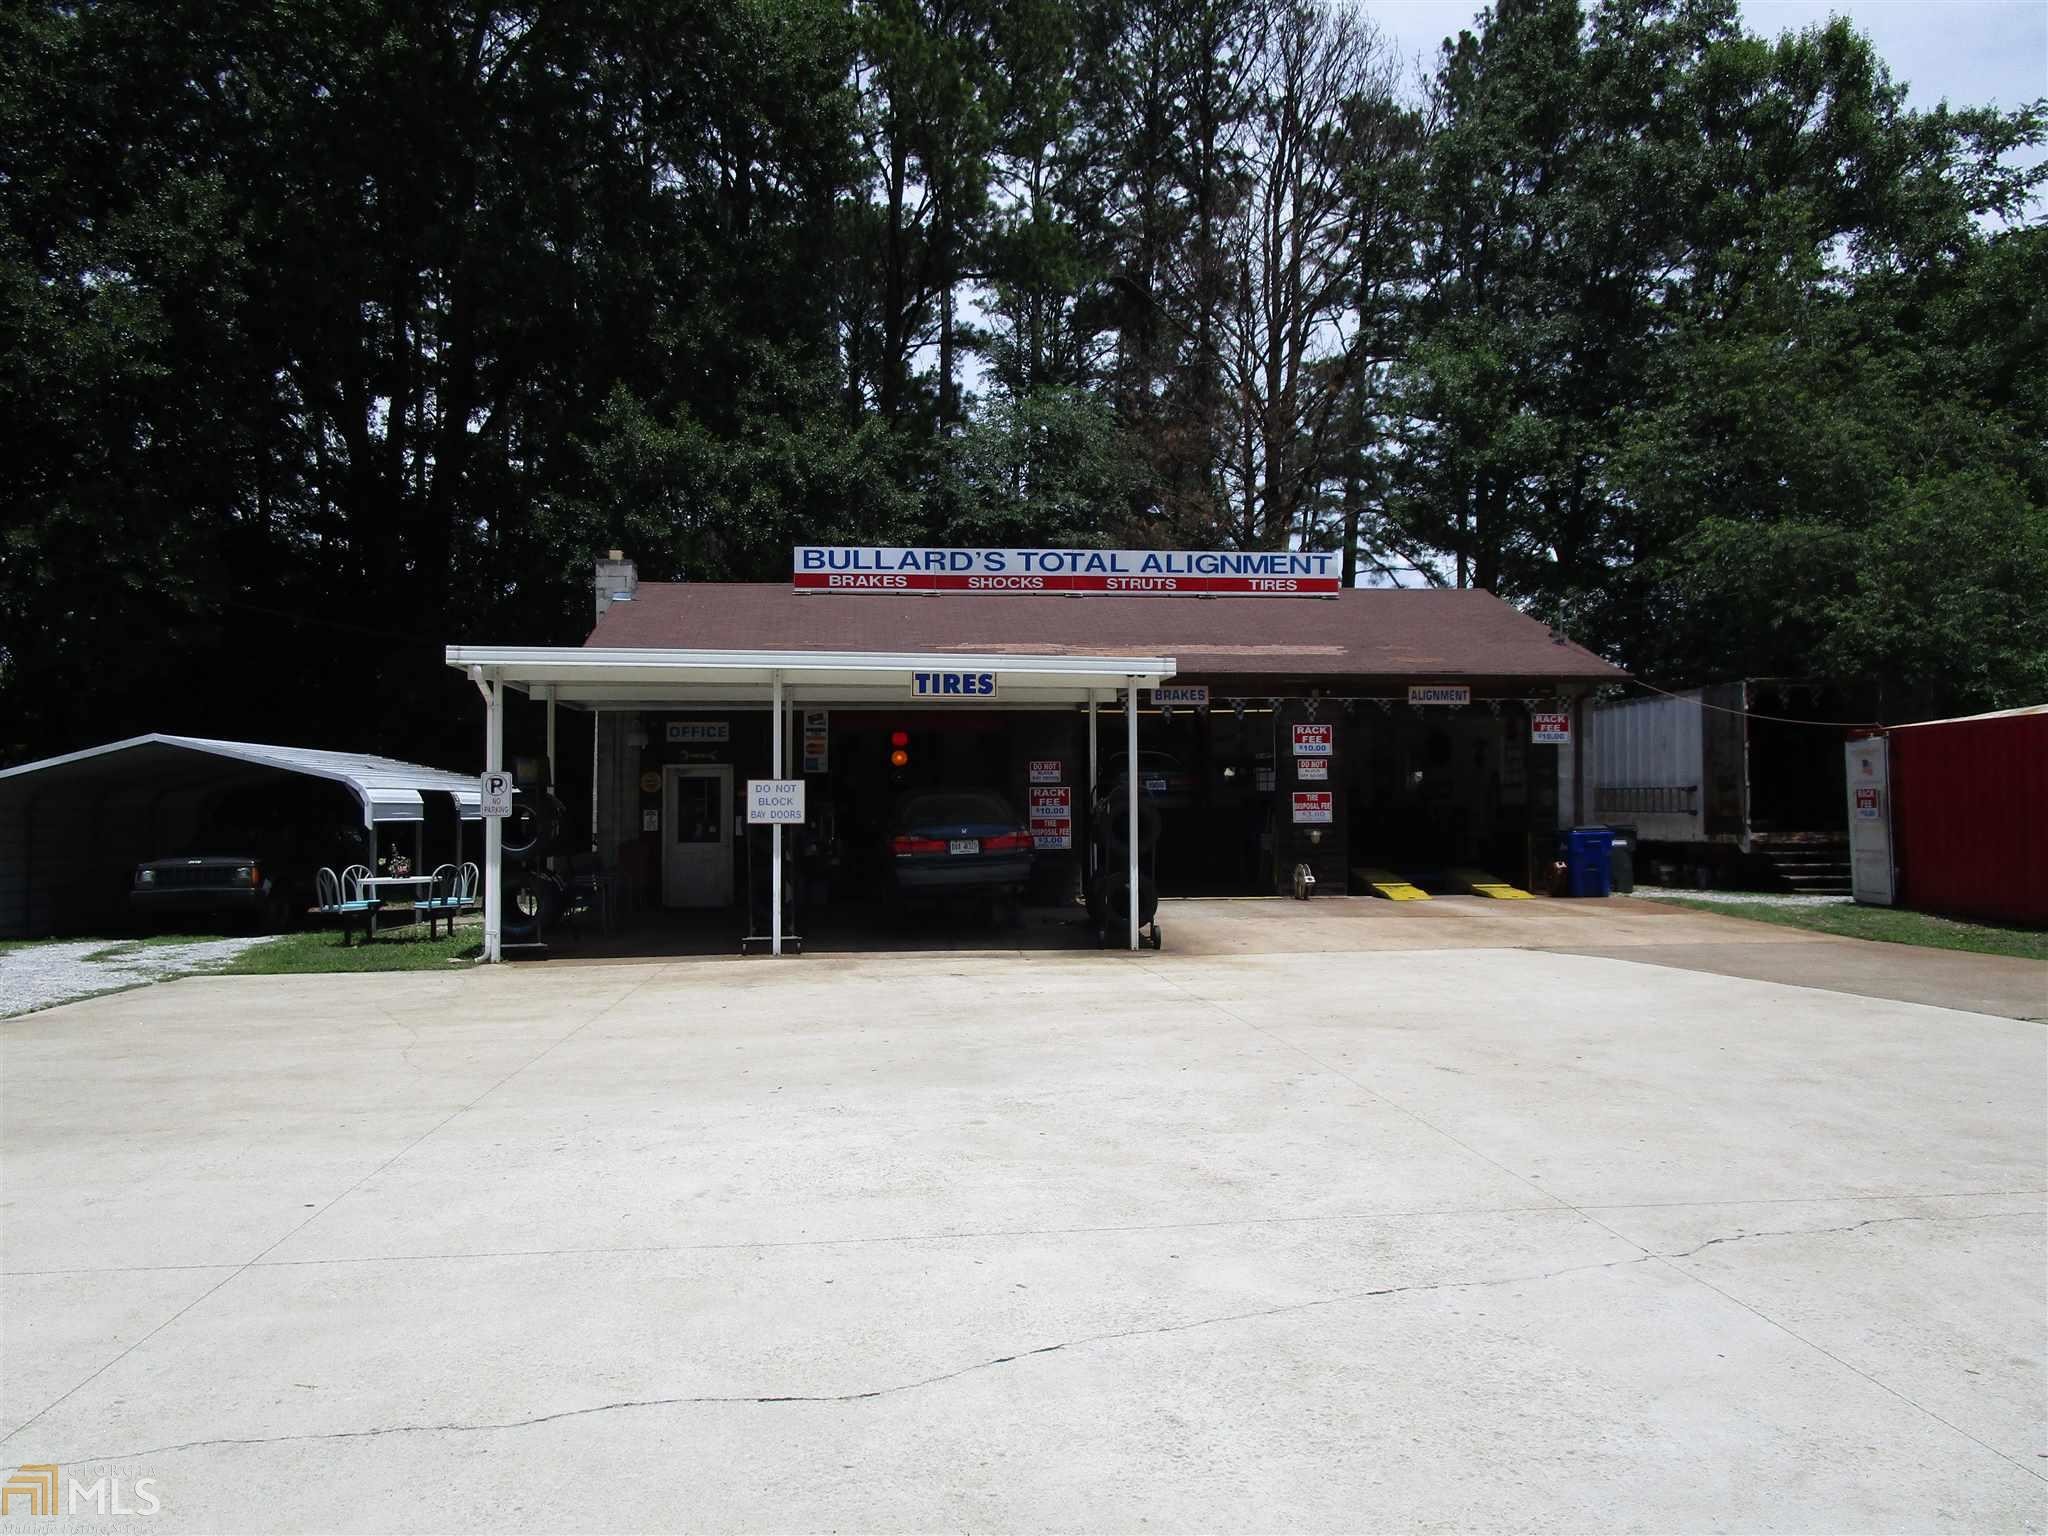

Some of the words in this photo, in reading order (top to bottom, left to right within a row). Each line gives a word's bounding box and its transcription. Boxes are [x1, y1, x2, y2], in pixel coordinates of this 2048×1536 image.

[803, 550, 1006, 572] BULLARD'S
[1017, 552, 1129, 573] TOTAL
[1140, 553, 1333, 575] ALIGNMENT
[828, 575, 908, 588] BRAKES
[968, 577, 1044, 589] SHOCKS
[1106, 578, 1177, 590] STRUTS
[1248, 579, 1298, 591] TIRES
[914, 673, 994, 694] TIRES
[1155, 689, 1206, 701] BRAKES
[1411, 690, 1468, 701] ALIGNMENT
[1535, 715, 1566, 723] RACK
[670, 726, 728, 737] OFFICE
[1296, 726, 1328, 734] RACK
[1540, 724, 1561, 732] FEE
[1302, 735, 1323, 743] FEE
[1299, 744, 1327, 752] $10.00
[755, 784, 770, 793] DO
[775, 784, 797, 793] NOT
[1033, 789, 1067, 797] RACK
[758, 797, 794, 806] BLOCK
[1040, 798, 1061, 806] FEE
[751, 810, 766, 819] BAY
[770, 810, 801, 819] DOORS
